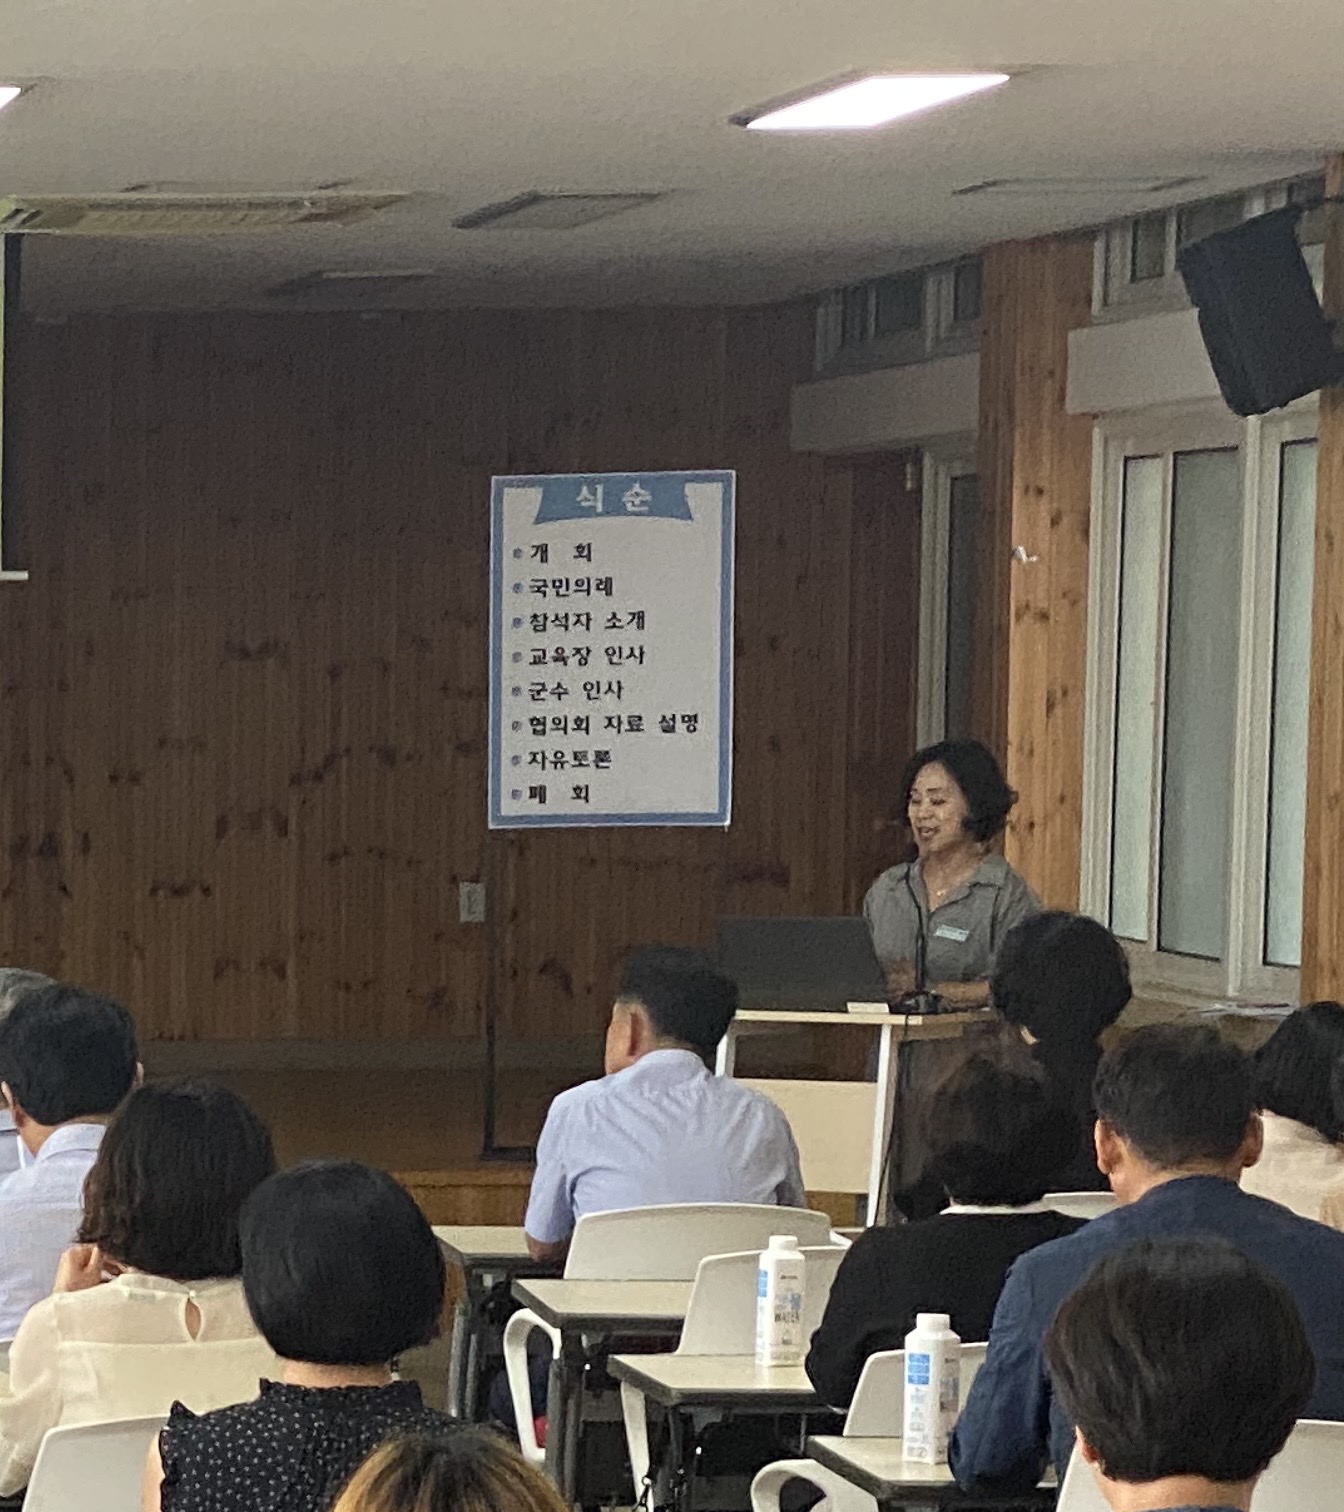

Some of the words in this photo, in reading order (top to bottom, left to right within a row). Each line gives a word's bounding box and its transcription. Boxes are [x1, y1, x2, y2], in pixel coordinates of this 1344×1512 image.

[529, 577, 613, 597] 국민의례
[529, 612, 592, 632] 참석자
[604, 611, 645, 631] 소개
[529, 647, 592, 667] 교육장
[604, 645, 646, 666] 인사
[528, 681, 569, 701] 군수
[583, 680, 624, 700] 인사
[529, 715, 591, 736] 협의회
[604, 714, 645, 734] 자료
[659, 713, 699, 734] 설명
[528, 750, 612, 770] 자유토론
